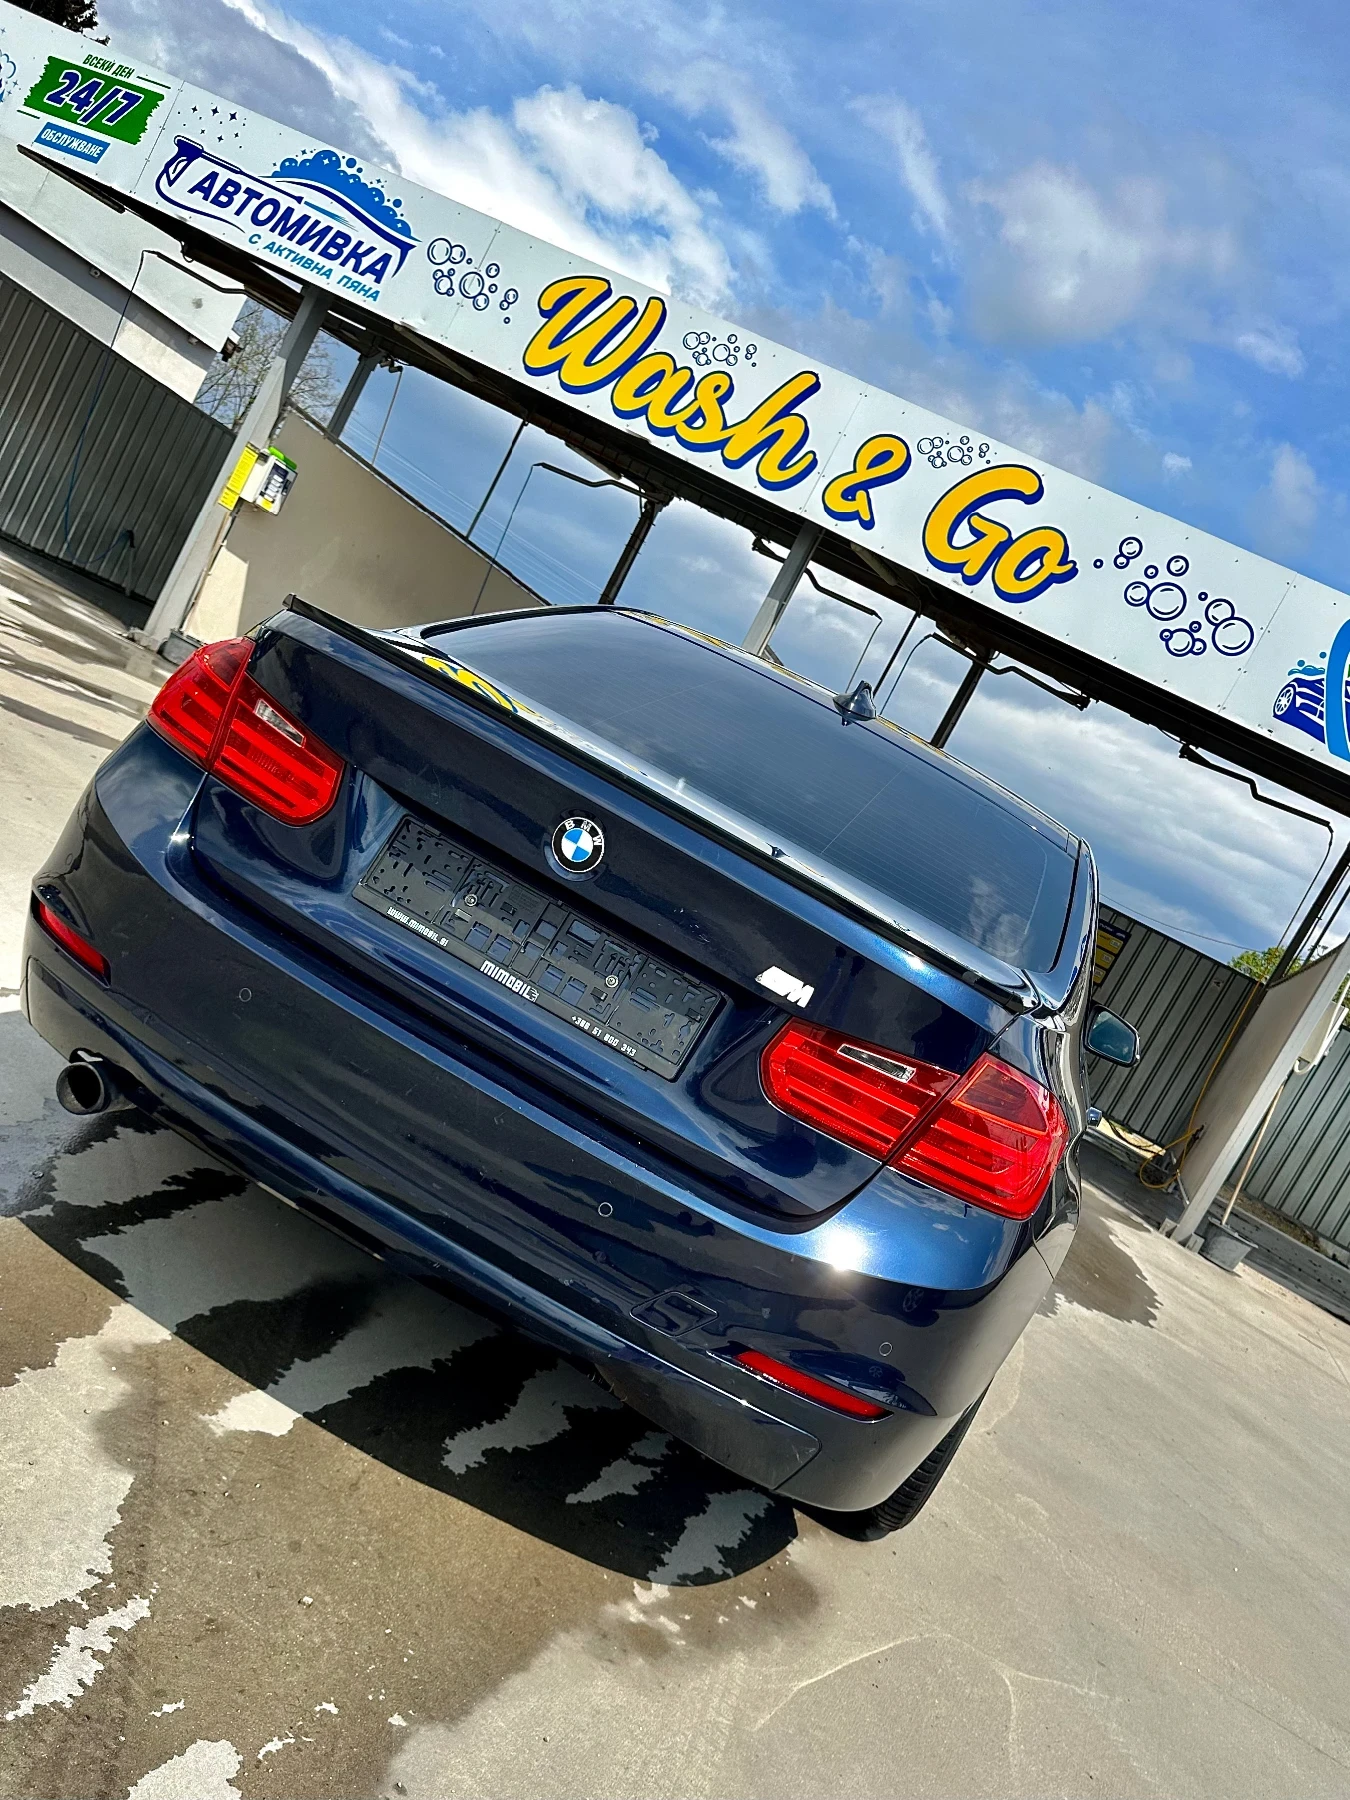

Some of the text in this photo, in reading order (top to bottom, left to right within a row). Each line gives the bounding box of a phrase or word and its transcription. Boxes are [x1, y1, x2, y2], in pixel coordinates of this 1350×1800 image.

[82, 54, 135, 79] ВСЕКИ ДЕН
[43, 70, 144, 126] 24/7
[40, 128, 104, 158] ОБСЛУЖВАНЕ
[187, 170, 393, 284] АВТОМИВКА
[248, 233, 381, 302] С АКТИВНА ПЯНА
[522, 275, 1079, 603] Wash & Go
[564, 819, 604, 846] BMW
[620, 1043, 637, 1057] 343
